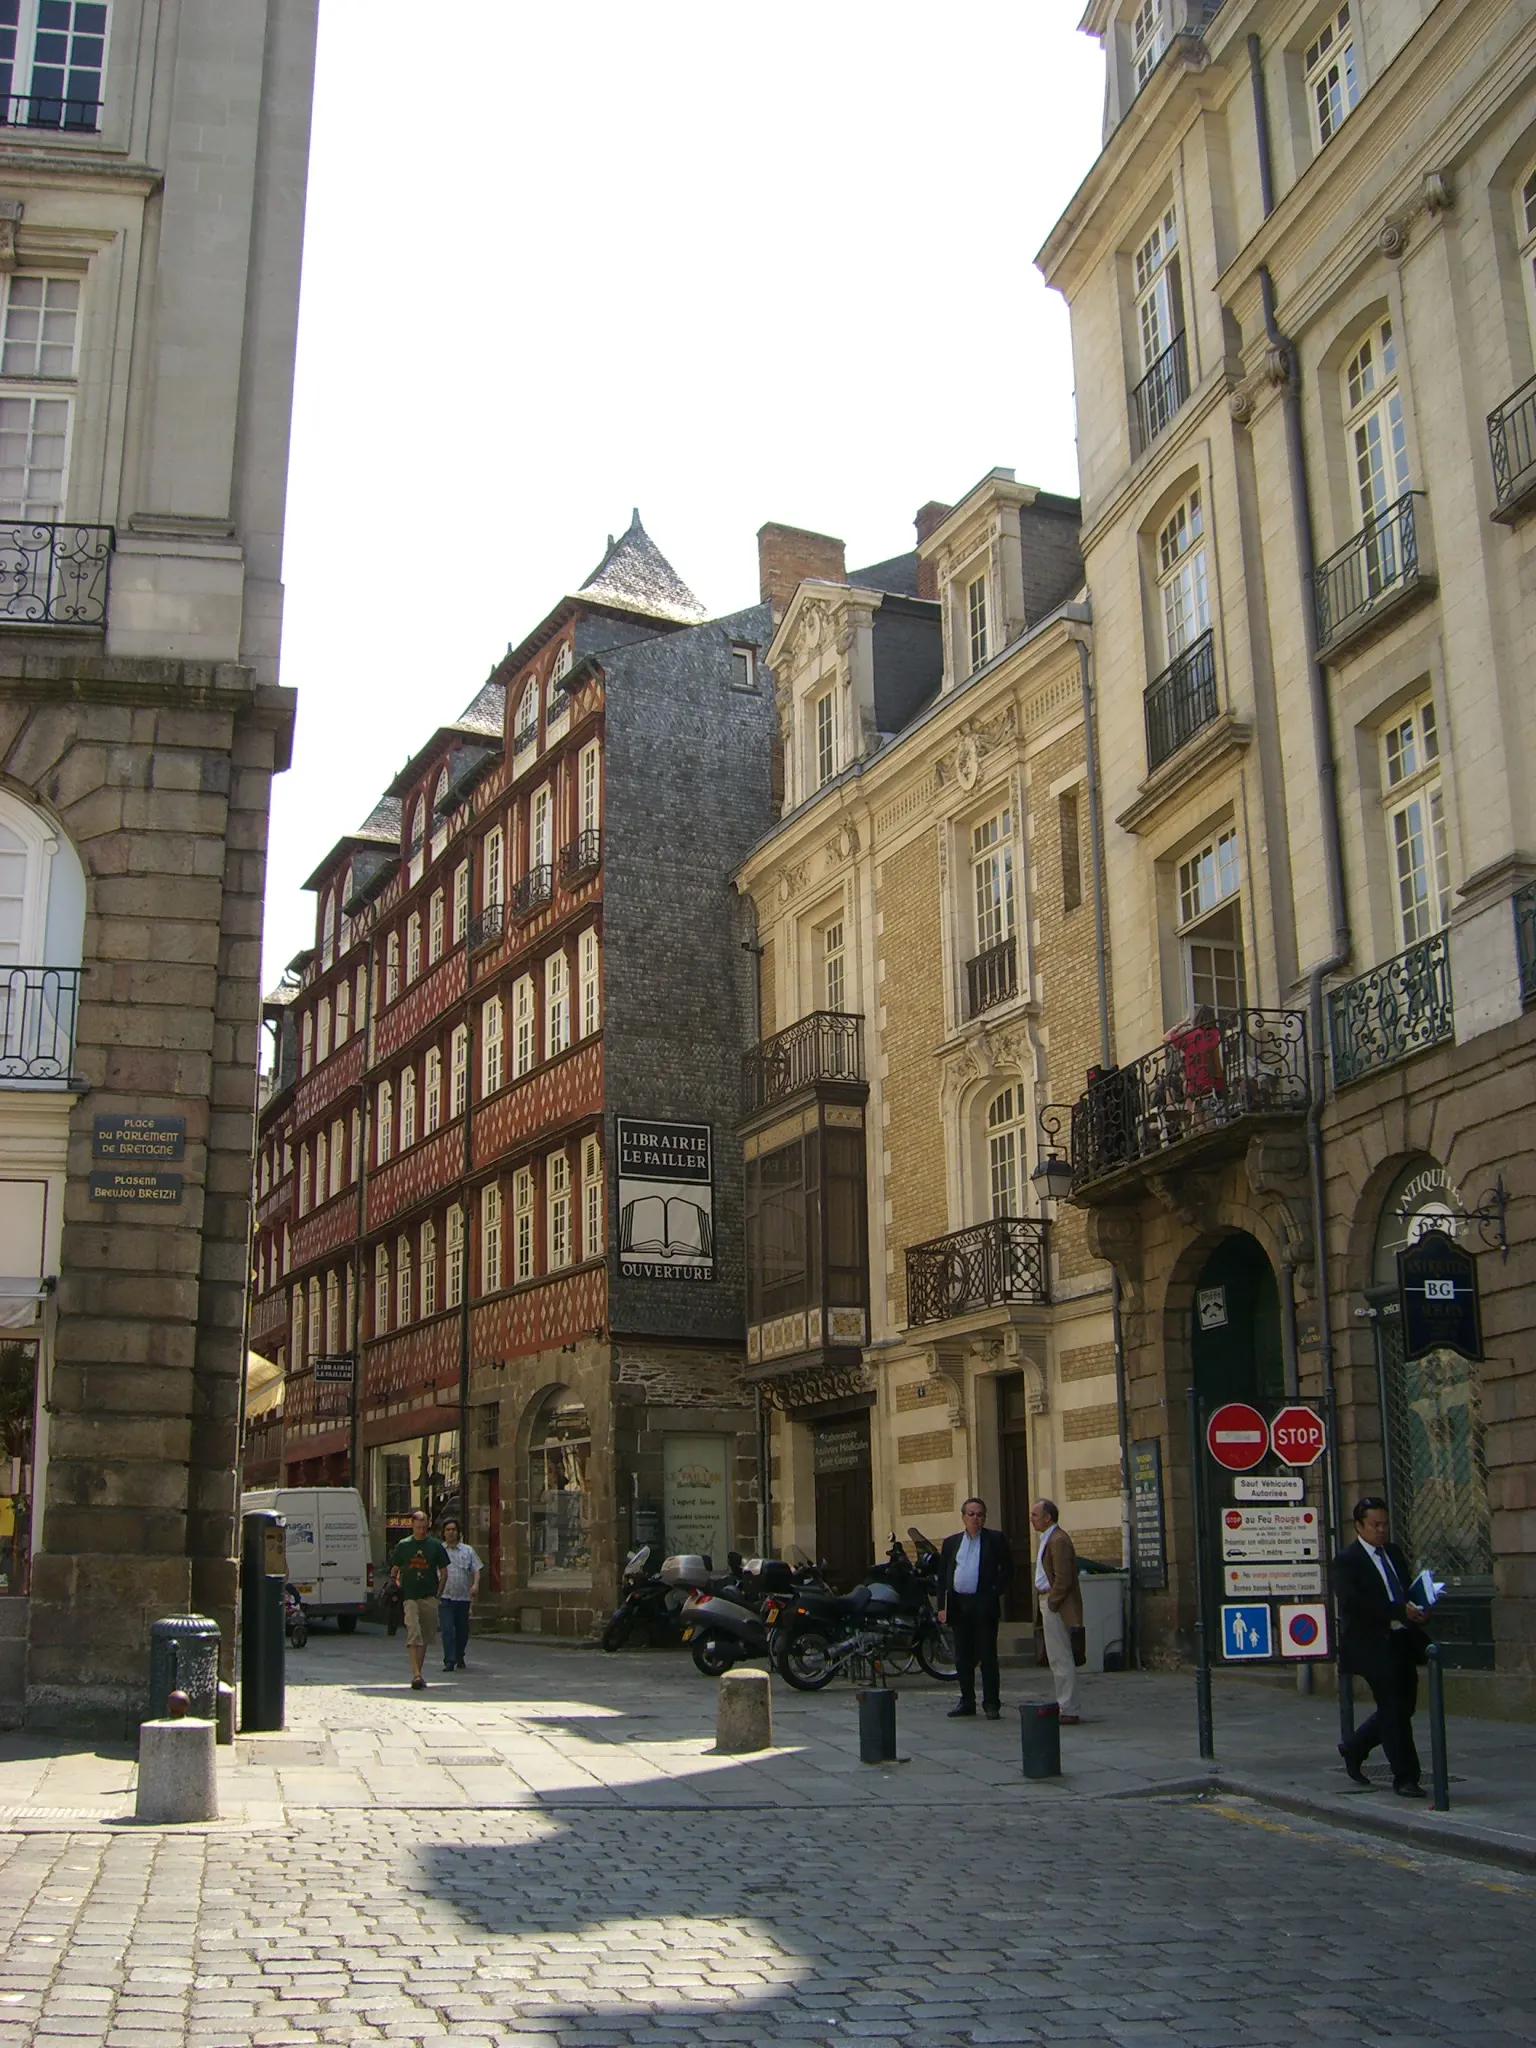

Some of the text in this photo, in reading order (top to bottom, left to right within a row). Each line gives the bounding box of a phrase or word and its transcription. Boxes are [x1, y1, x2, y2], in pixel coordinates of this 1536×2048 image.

[124, 1119, 155, 1129] PLACE
[98, 1131, 179, 1142] DU PARLEMENT
[622, 1131, 707, 1151] LIBRAIRIE
[102, 1143, 174, 1155] DE BRETAGNE
[622, 1149, 707, 1169] LE FAILLER
[114, 1175, 157, 1186] PLASENN
[138, 1188, 177, 1200] BREIZH
[621, 1263, 713, 1281] OUVERTURE
[1427, 1282, 1451, 1297] BG
[1277, 1427, 1320, 1446] STOP
[1240, 1479, 1298, 1488] Sauf Véhicules
[1251, 1489, 1288, 1497] Autorisés
[1225, 1514, 1300, 1524] STOP au Feu Rouge
